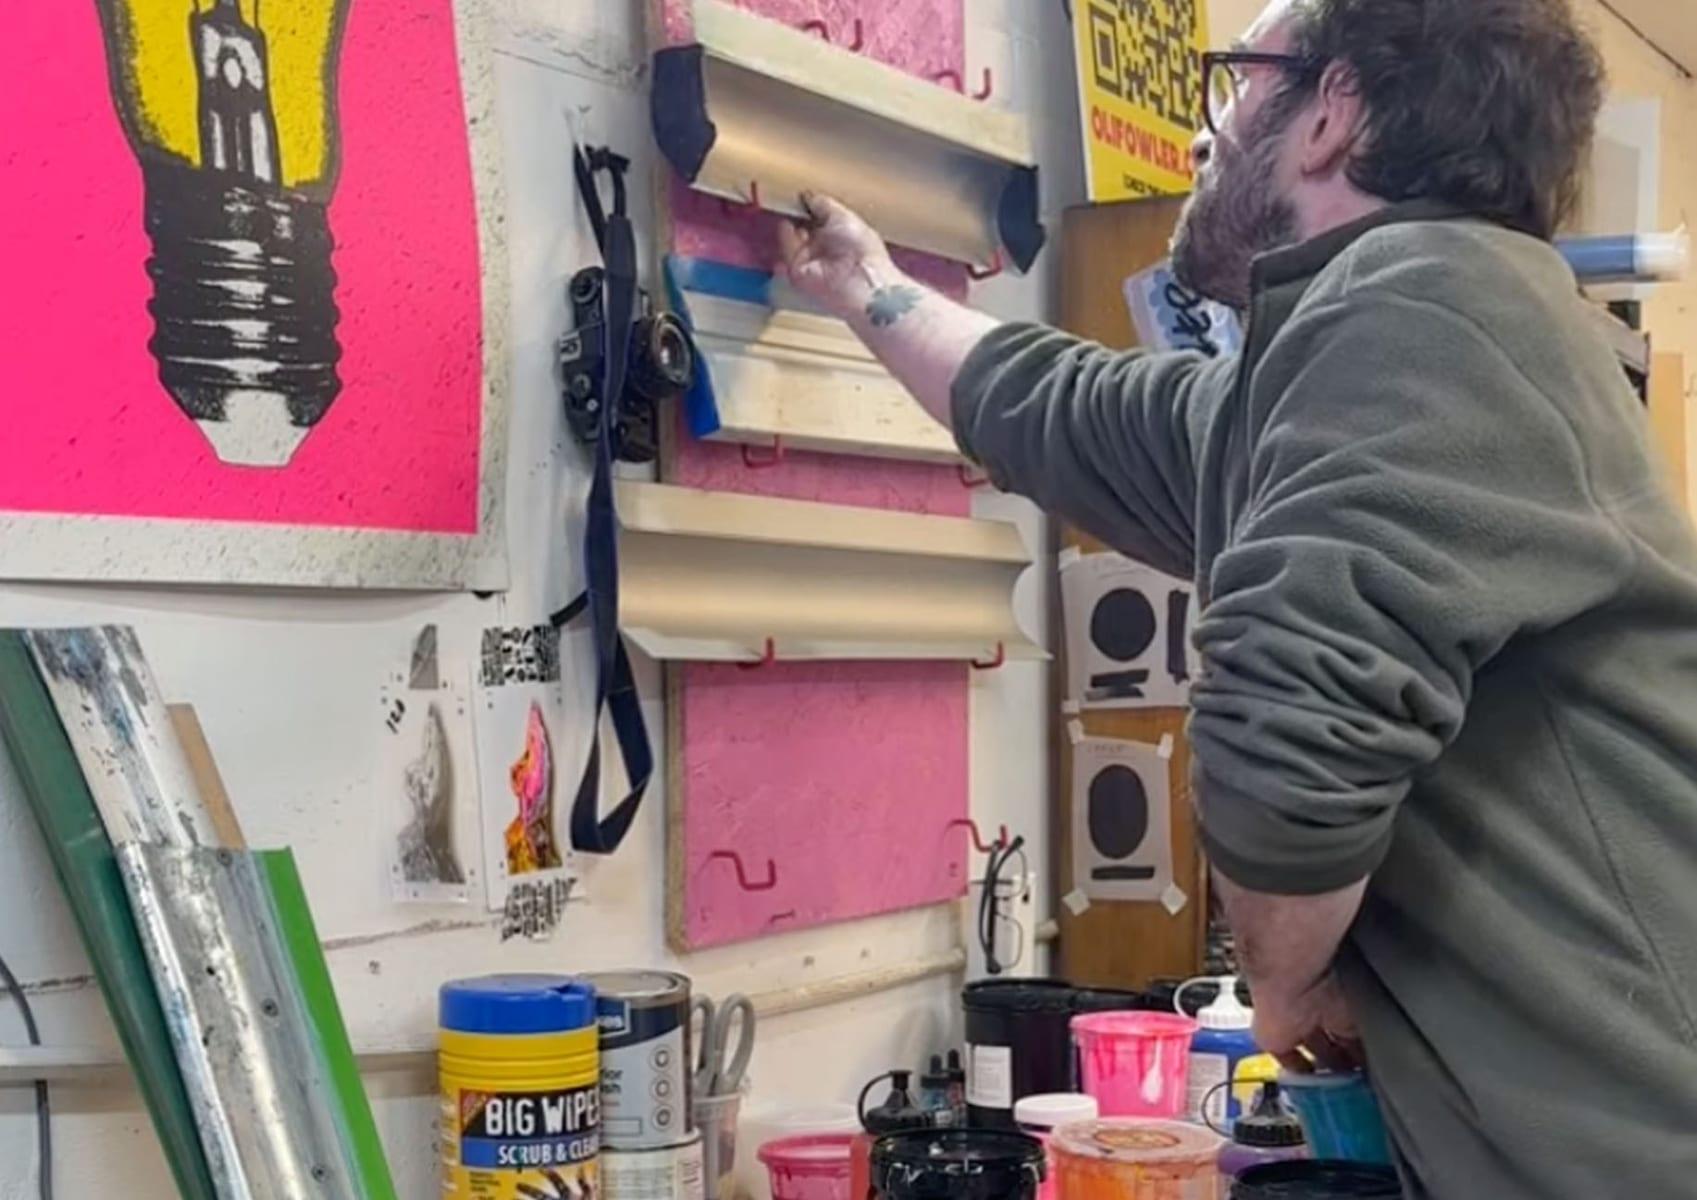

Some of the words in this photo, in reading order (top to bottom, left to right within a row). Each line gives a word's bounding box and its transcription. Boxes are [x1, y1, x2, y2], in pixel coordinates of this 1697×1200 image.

[485, 1098, 535, 1136] BIG
[541, 1086, 600, 1134] WIPE
[498, 1144, 552, 1165] SCRUB
[556, 1142, 568, 1162] &
